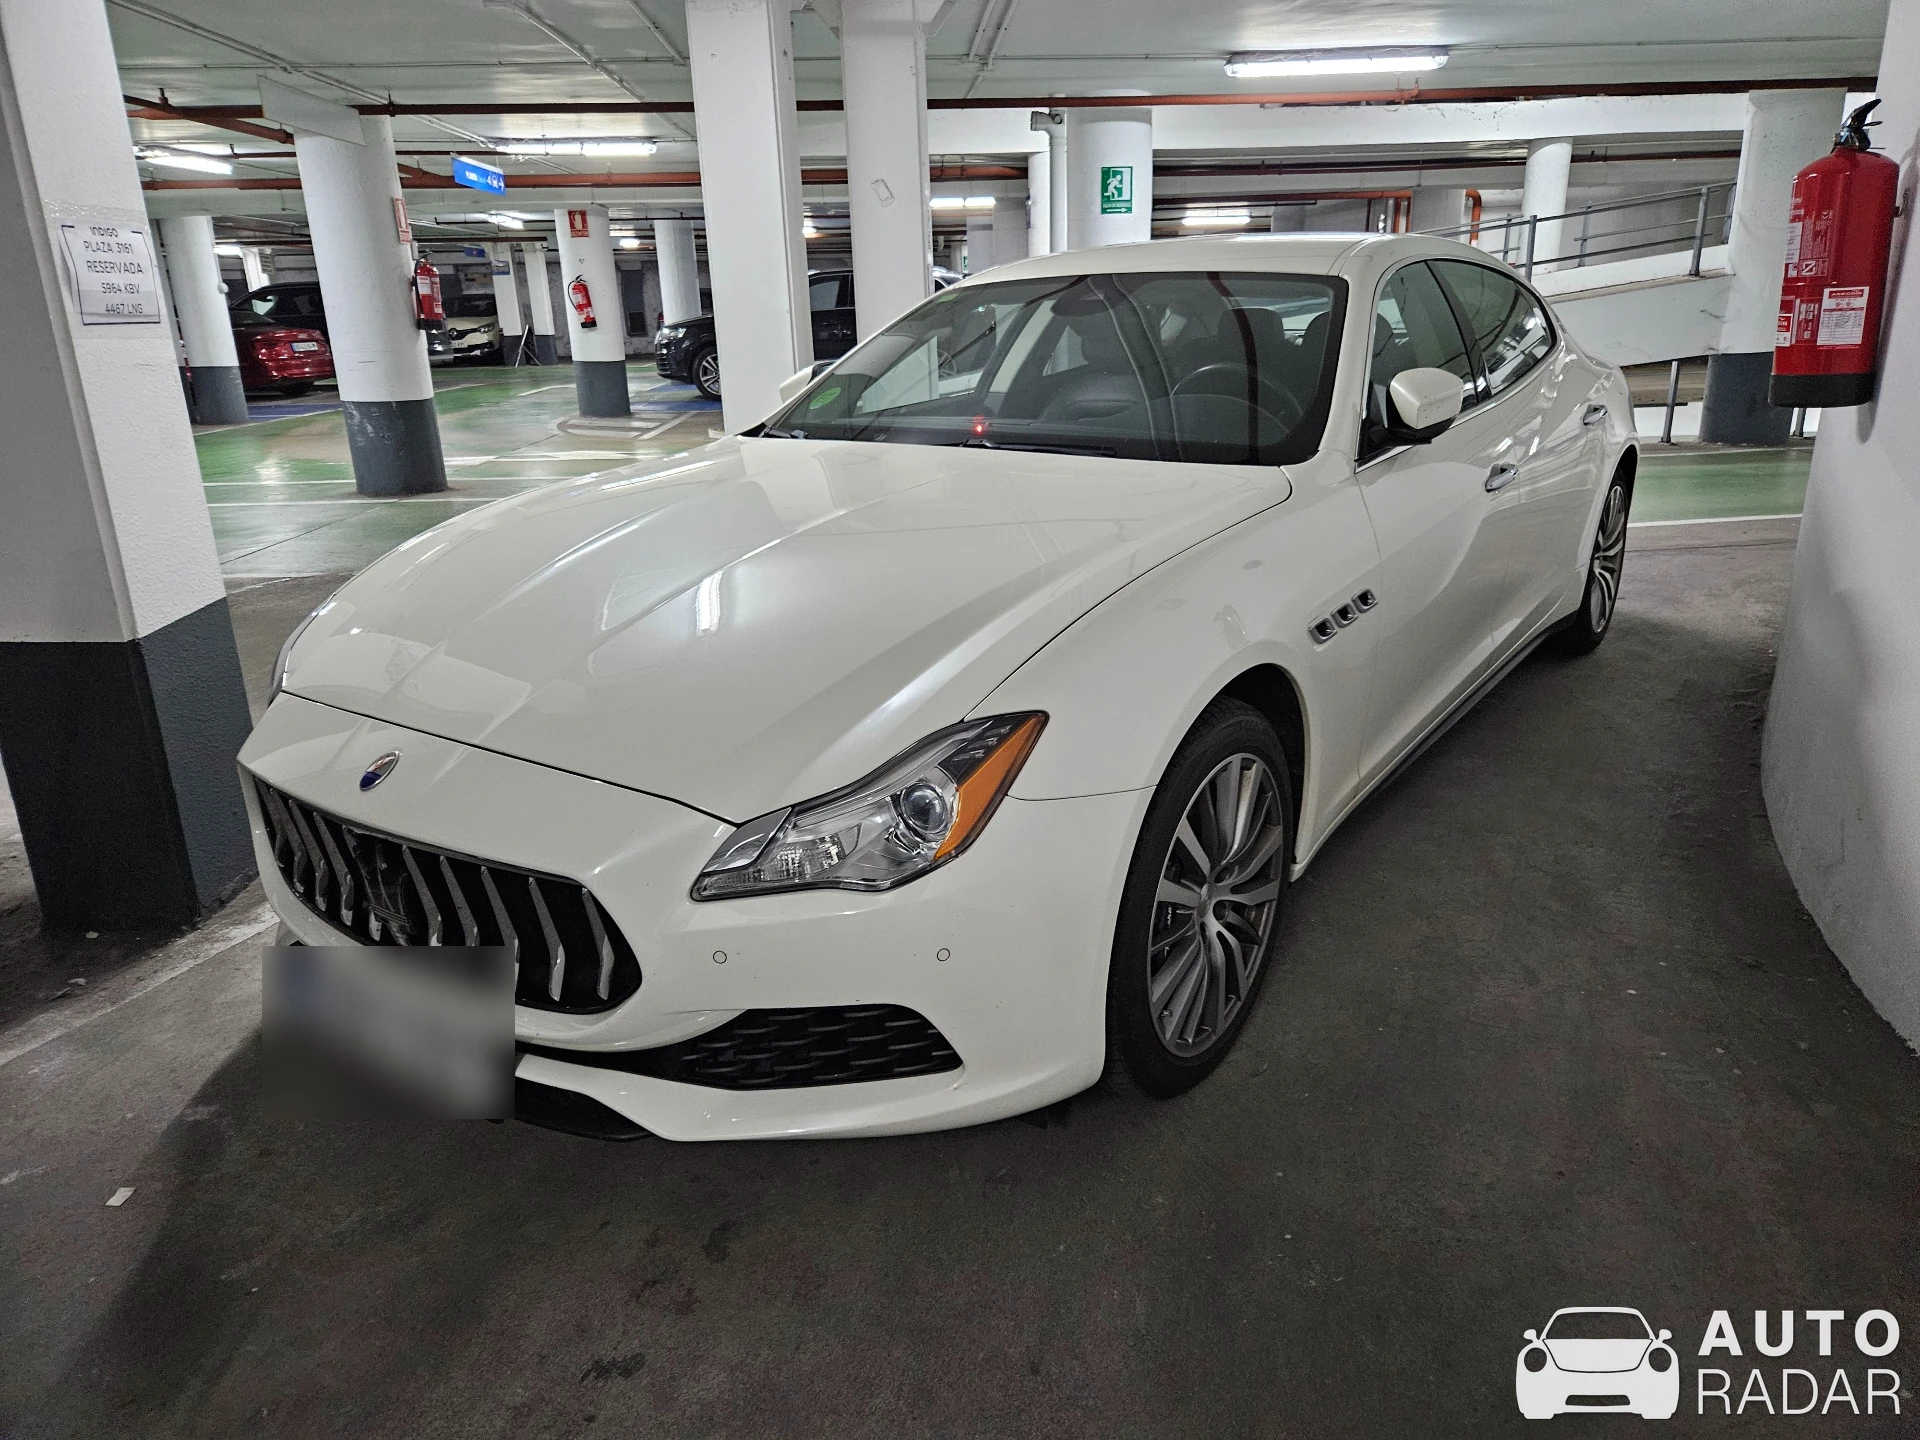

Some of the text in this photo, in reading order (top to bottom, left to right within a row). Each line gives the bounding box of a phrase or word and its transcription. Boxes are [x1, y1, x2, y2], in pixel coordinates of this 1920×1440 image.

[83, 240, 134, 254] PLAZA 3161
[86, 260, 144, 275] RESERVADA
[101, 282, 140, 294] 5964 KBV
[105, 303, 143, 314] 4467 LNG
